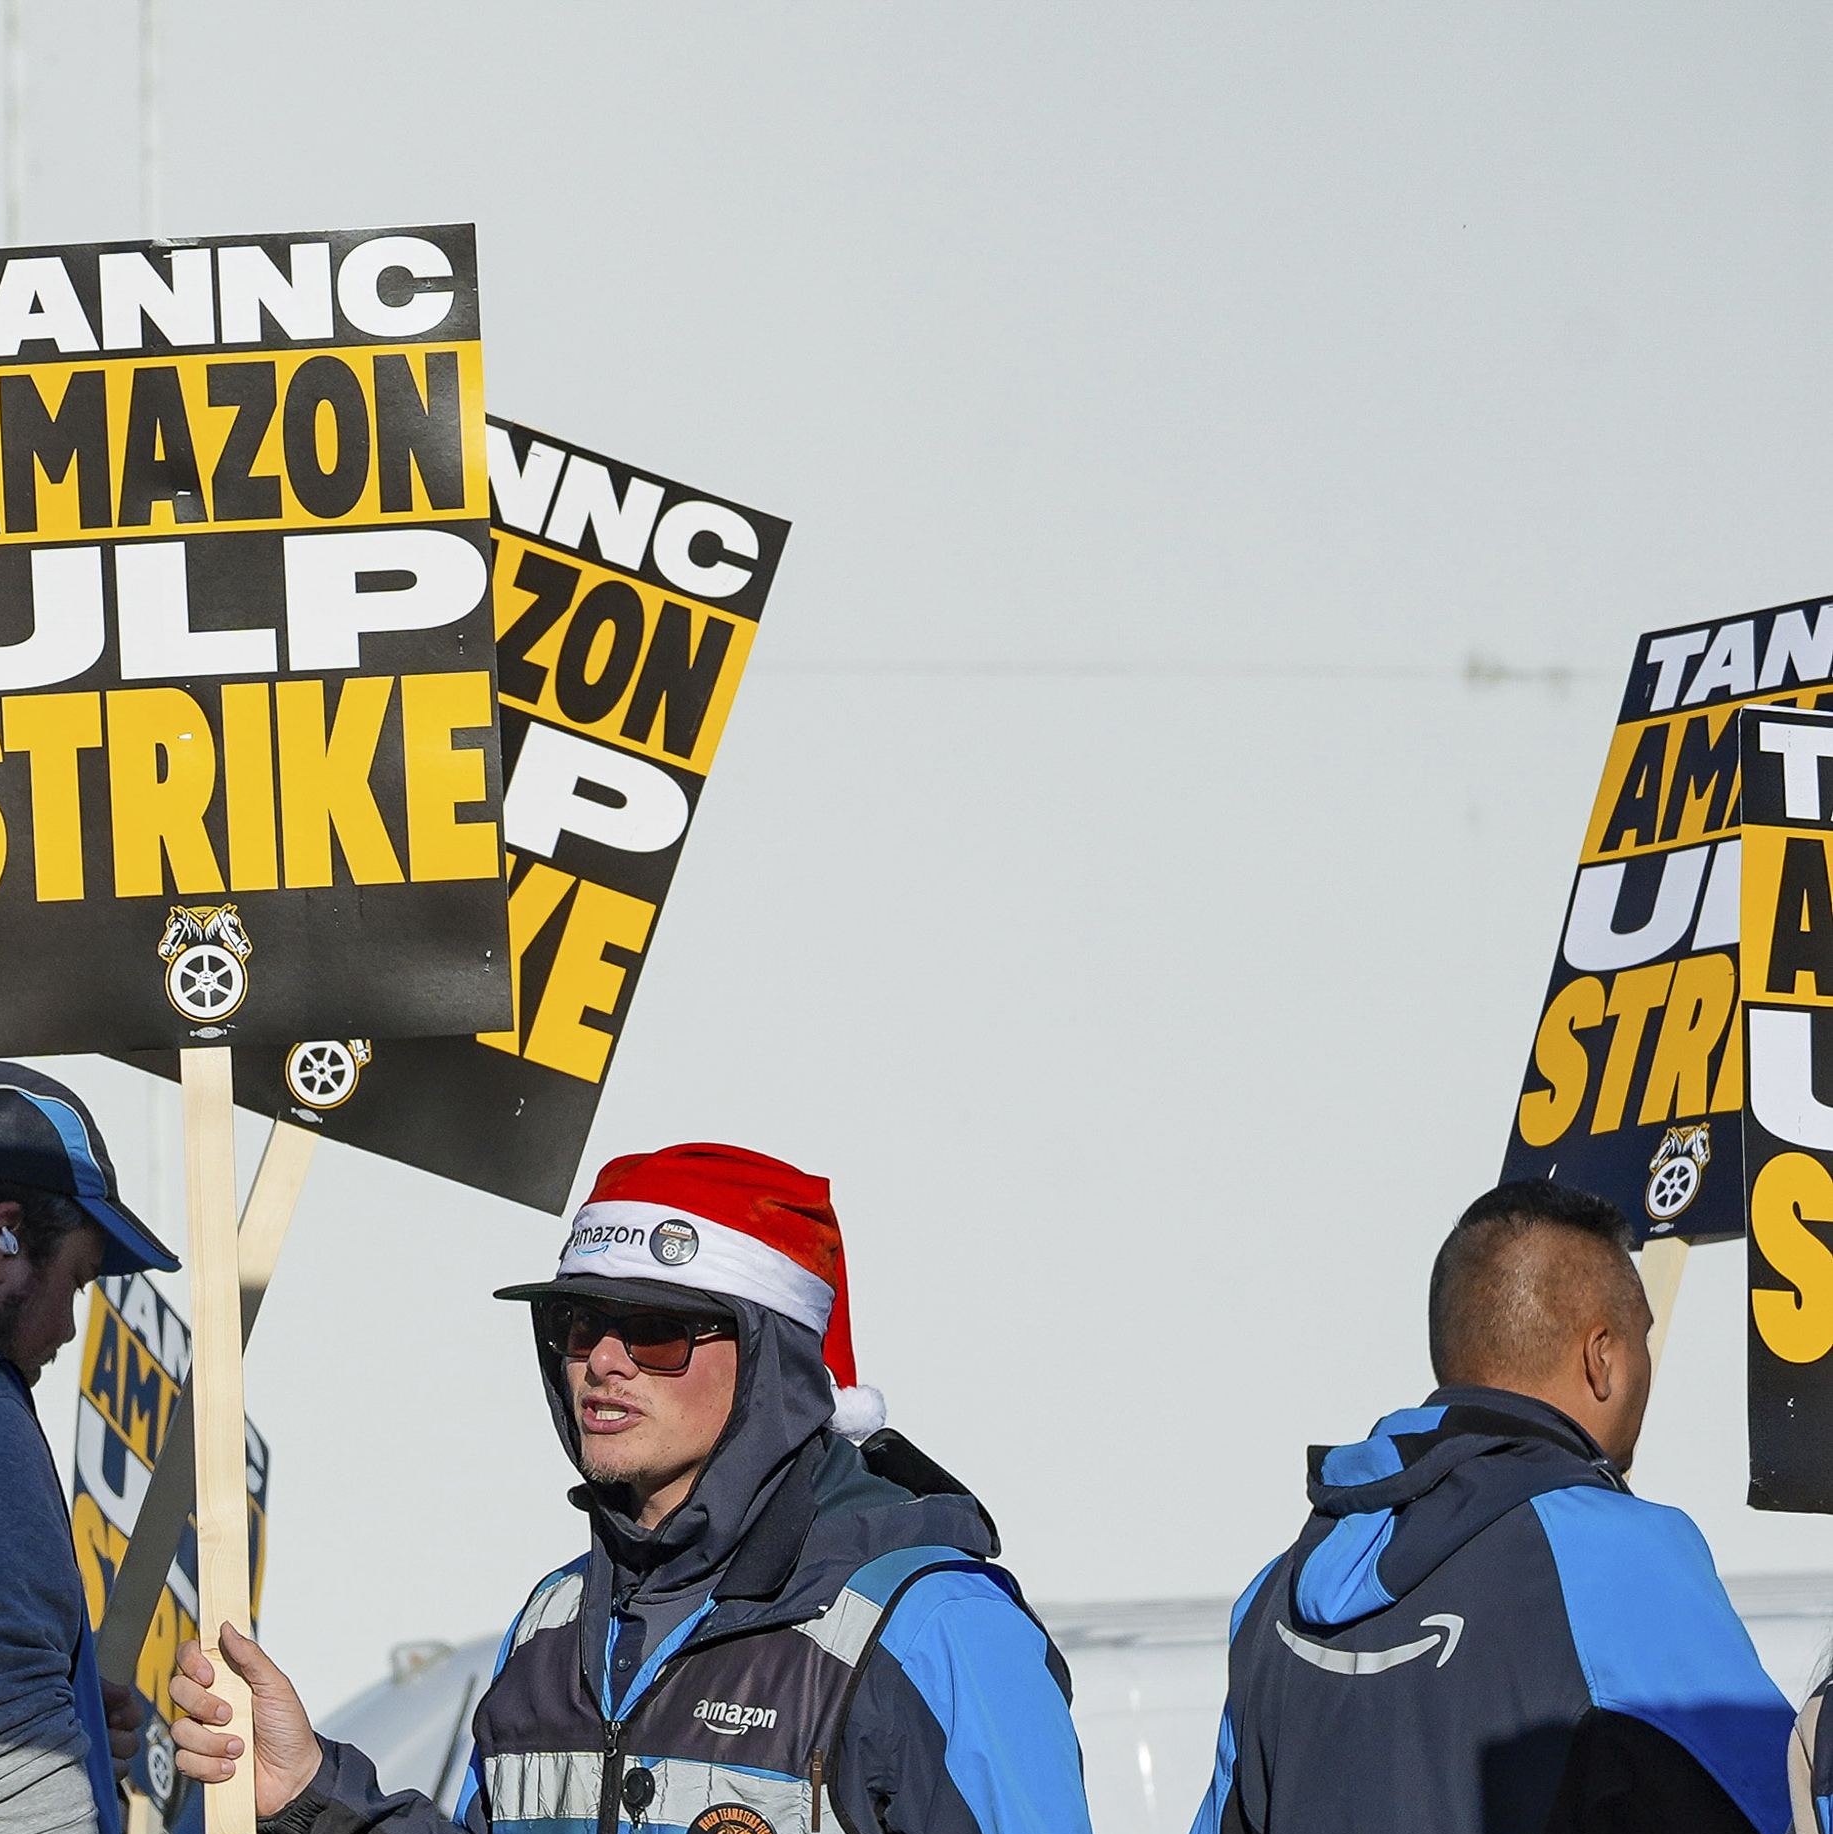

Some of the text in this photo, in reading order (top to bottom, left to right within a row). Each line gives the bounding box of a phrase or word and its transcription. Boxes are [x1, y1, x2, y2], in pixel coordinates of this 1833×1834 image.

[485, 423, 759, 598] NNC
[494, 548, 736, 760] ZON
[1646, 604, 1833, 713] TAN
[573, 1226, 645, 1248] amazon
[693, 1699, 778, 1729] amazon
[718, 1808, 761, 1829] TEAMSTERS
